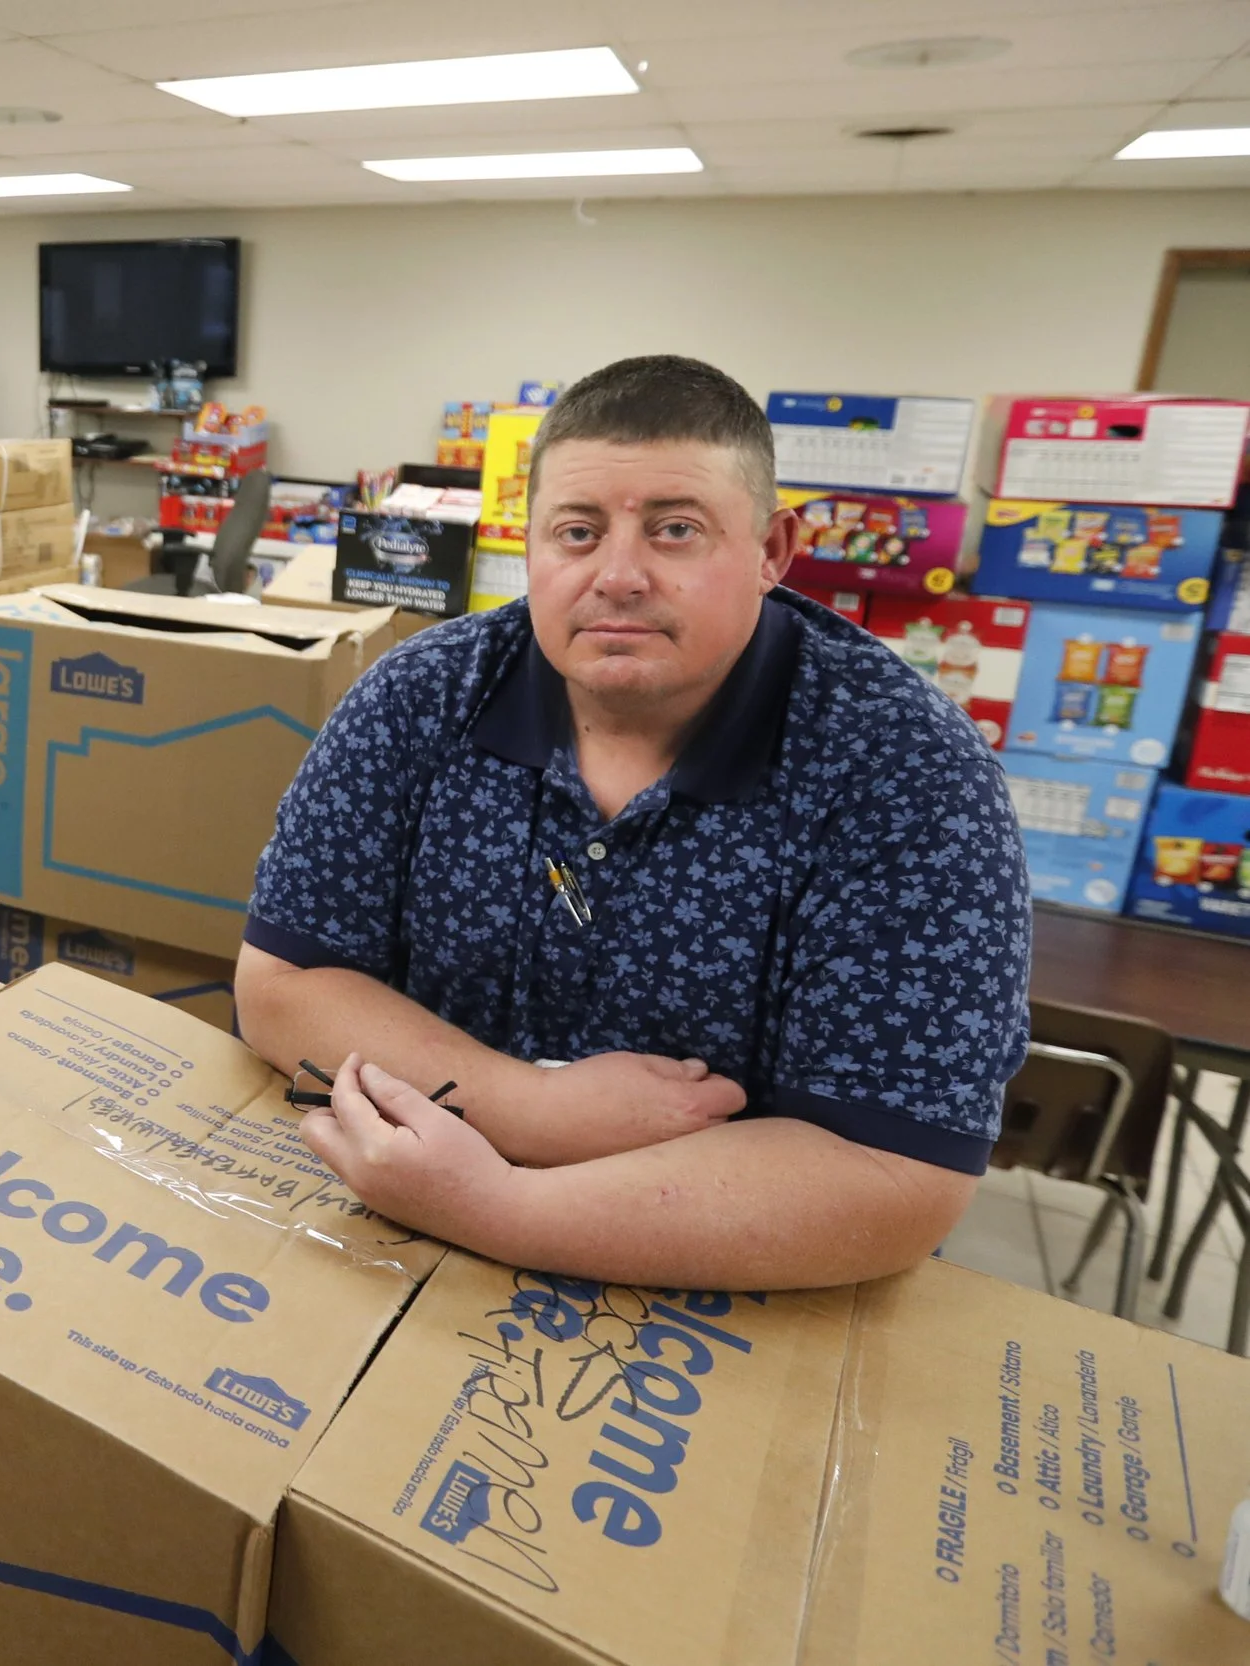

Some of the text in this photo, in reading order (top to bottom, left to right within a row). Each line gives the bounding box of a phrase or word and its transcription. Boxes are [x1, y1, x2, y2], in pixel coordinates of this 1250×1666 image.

[377, 537, 427, 554] Pedialyte
[345, 588, 447, 612] LONGER THAN WATER
[347, 578, 447, 601] KEEP YOU HYDRATED
[436, 580, 451, 592] TO
[60, 665, 135, 699] LOWE'S
[93, 1046, 159, 1082] Laundry
[111, 1039, 168, 1072] Garage
[56, 1056, 135, 1100] Basement
[106, 1066, 147, 1090] Attic
[176, 1102, 227, 1135] familiar
[207, 1103, 277, 1134] Comedor
[228, 1127, 265, 1145] Sala
[206, 1131, 285, 1163] Dormitorio
[999, 1340, 1022, 1387] Sótano
[67, 1329, 93, 1350] This
[91, 1343, 120, 1363] side
[118, 1355, 138, 1372] up
[144, 1369, 175, 1391] Este
[173, 1384, 205, 1407] lado
[203, 1399, 245, 1427] hacia
[243, 1421, 291, 1449] arriba
[216, 1374, 299, 1423] LOWE'S
[1075, 1349, 1100, 1425] Lavandería
[439, 1413, 461, 1434] Este
[571, 1289, 767, 1549] elcome
[993, 1395, 1021, 1482] Basement
[1114, 1396, 1142, 1444] Garaje
[426, 1431, 451, 1457] lado
[947, 1436, 975, 1481] Frágil
[412, 1453, 438, 1486] hacia
[1035, 1446, 1062, 1496] Attic
[1075, 1433, 1106, 1509] Laundry
[1120, 1452, 1151, 1523] Garage
[392, 1483, 418, 1517] arriba
[430, 1470, 481, 1532] LOWE'S
[936, 1485, 968, 1570] FRAGILE
[995, 1563, 1020, 1654] Dormitorio
[1089, 1571, 1117, 1657] Comedor
